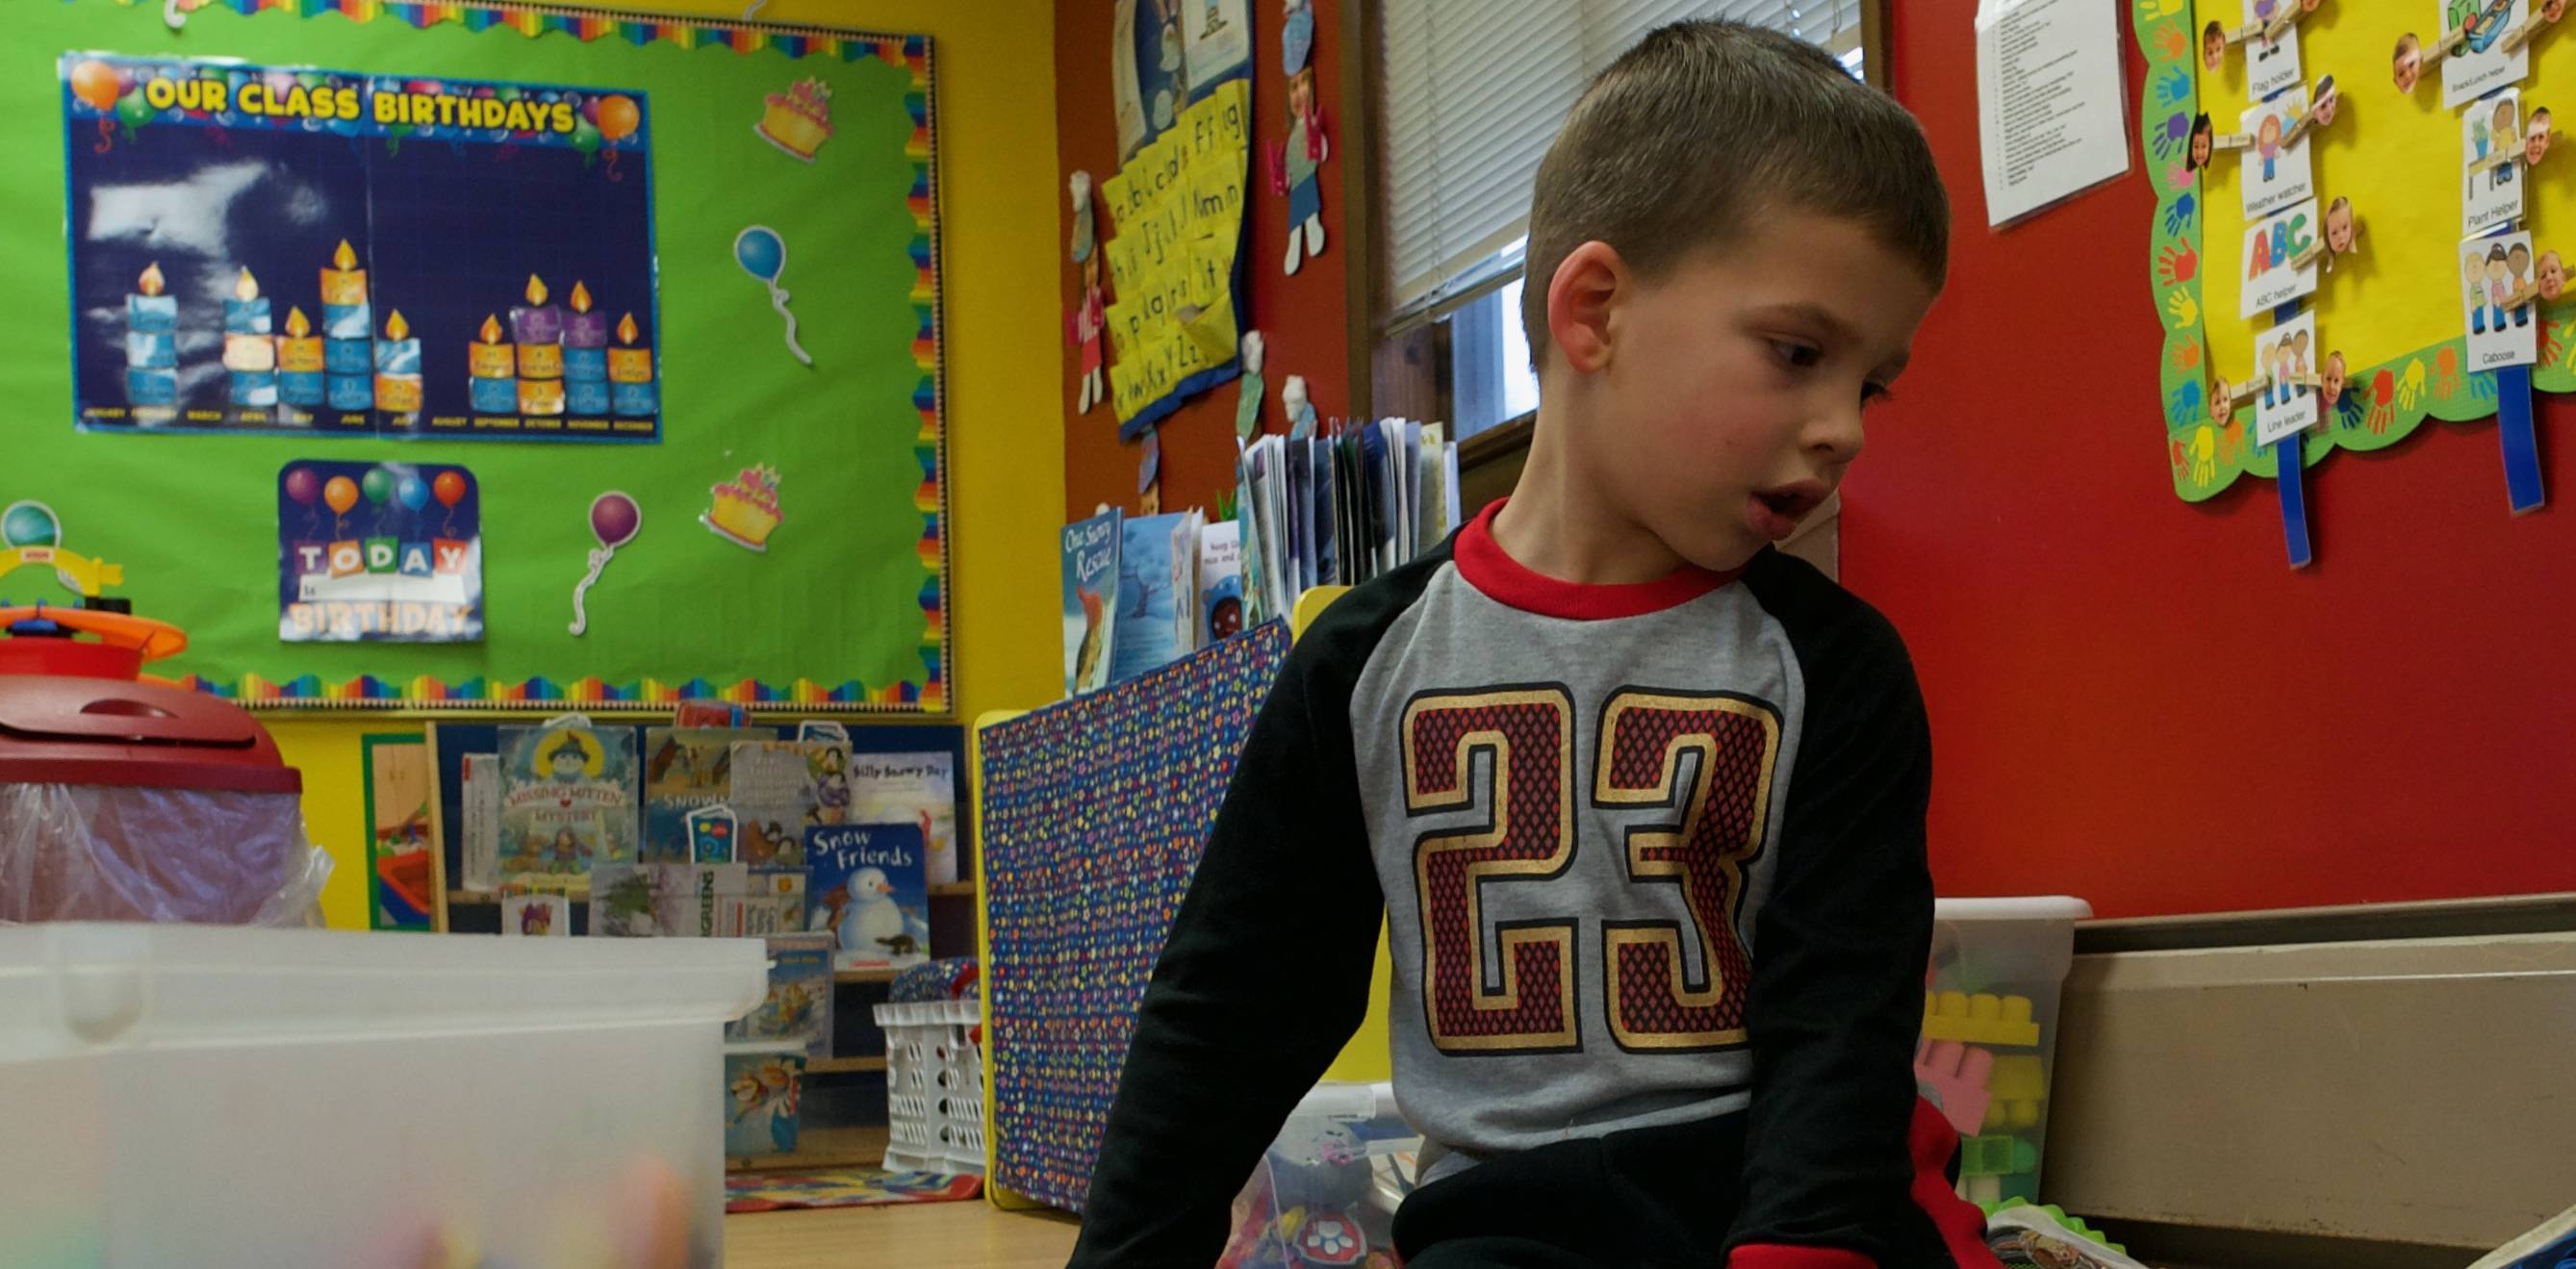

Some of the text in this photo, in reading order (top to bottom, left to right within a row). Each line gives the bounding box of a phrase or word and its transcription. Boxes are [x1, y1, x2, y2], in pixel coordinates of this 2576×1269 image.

[2253, 68, 2295, 93] Flag holder
[146, 77, 575, 134] OUR CLASS BIRTHDAYS
[2246, 183, 2307, 214] Weather watcher
[2468, 199, 2519, 228] Plant Helper
[2248, 213, 2311, 281] ABC
[2267, 410, 2307, 433] Line leader
[298, 544, 462, 572] TODAY
[289, 601, 472, 634] BIRTHDAY
[570, 786, 623, 806] MITTEN
[813, 830, 872, 856] Snow
[836, 846, 912, 871] Friends
[1399, 681, 1785, 1057] 23
